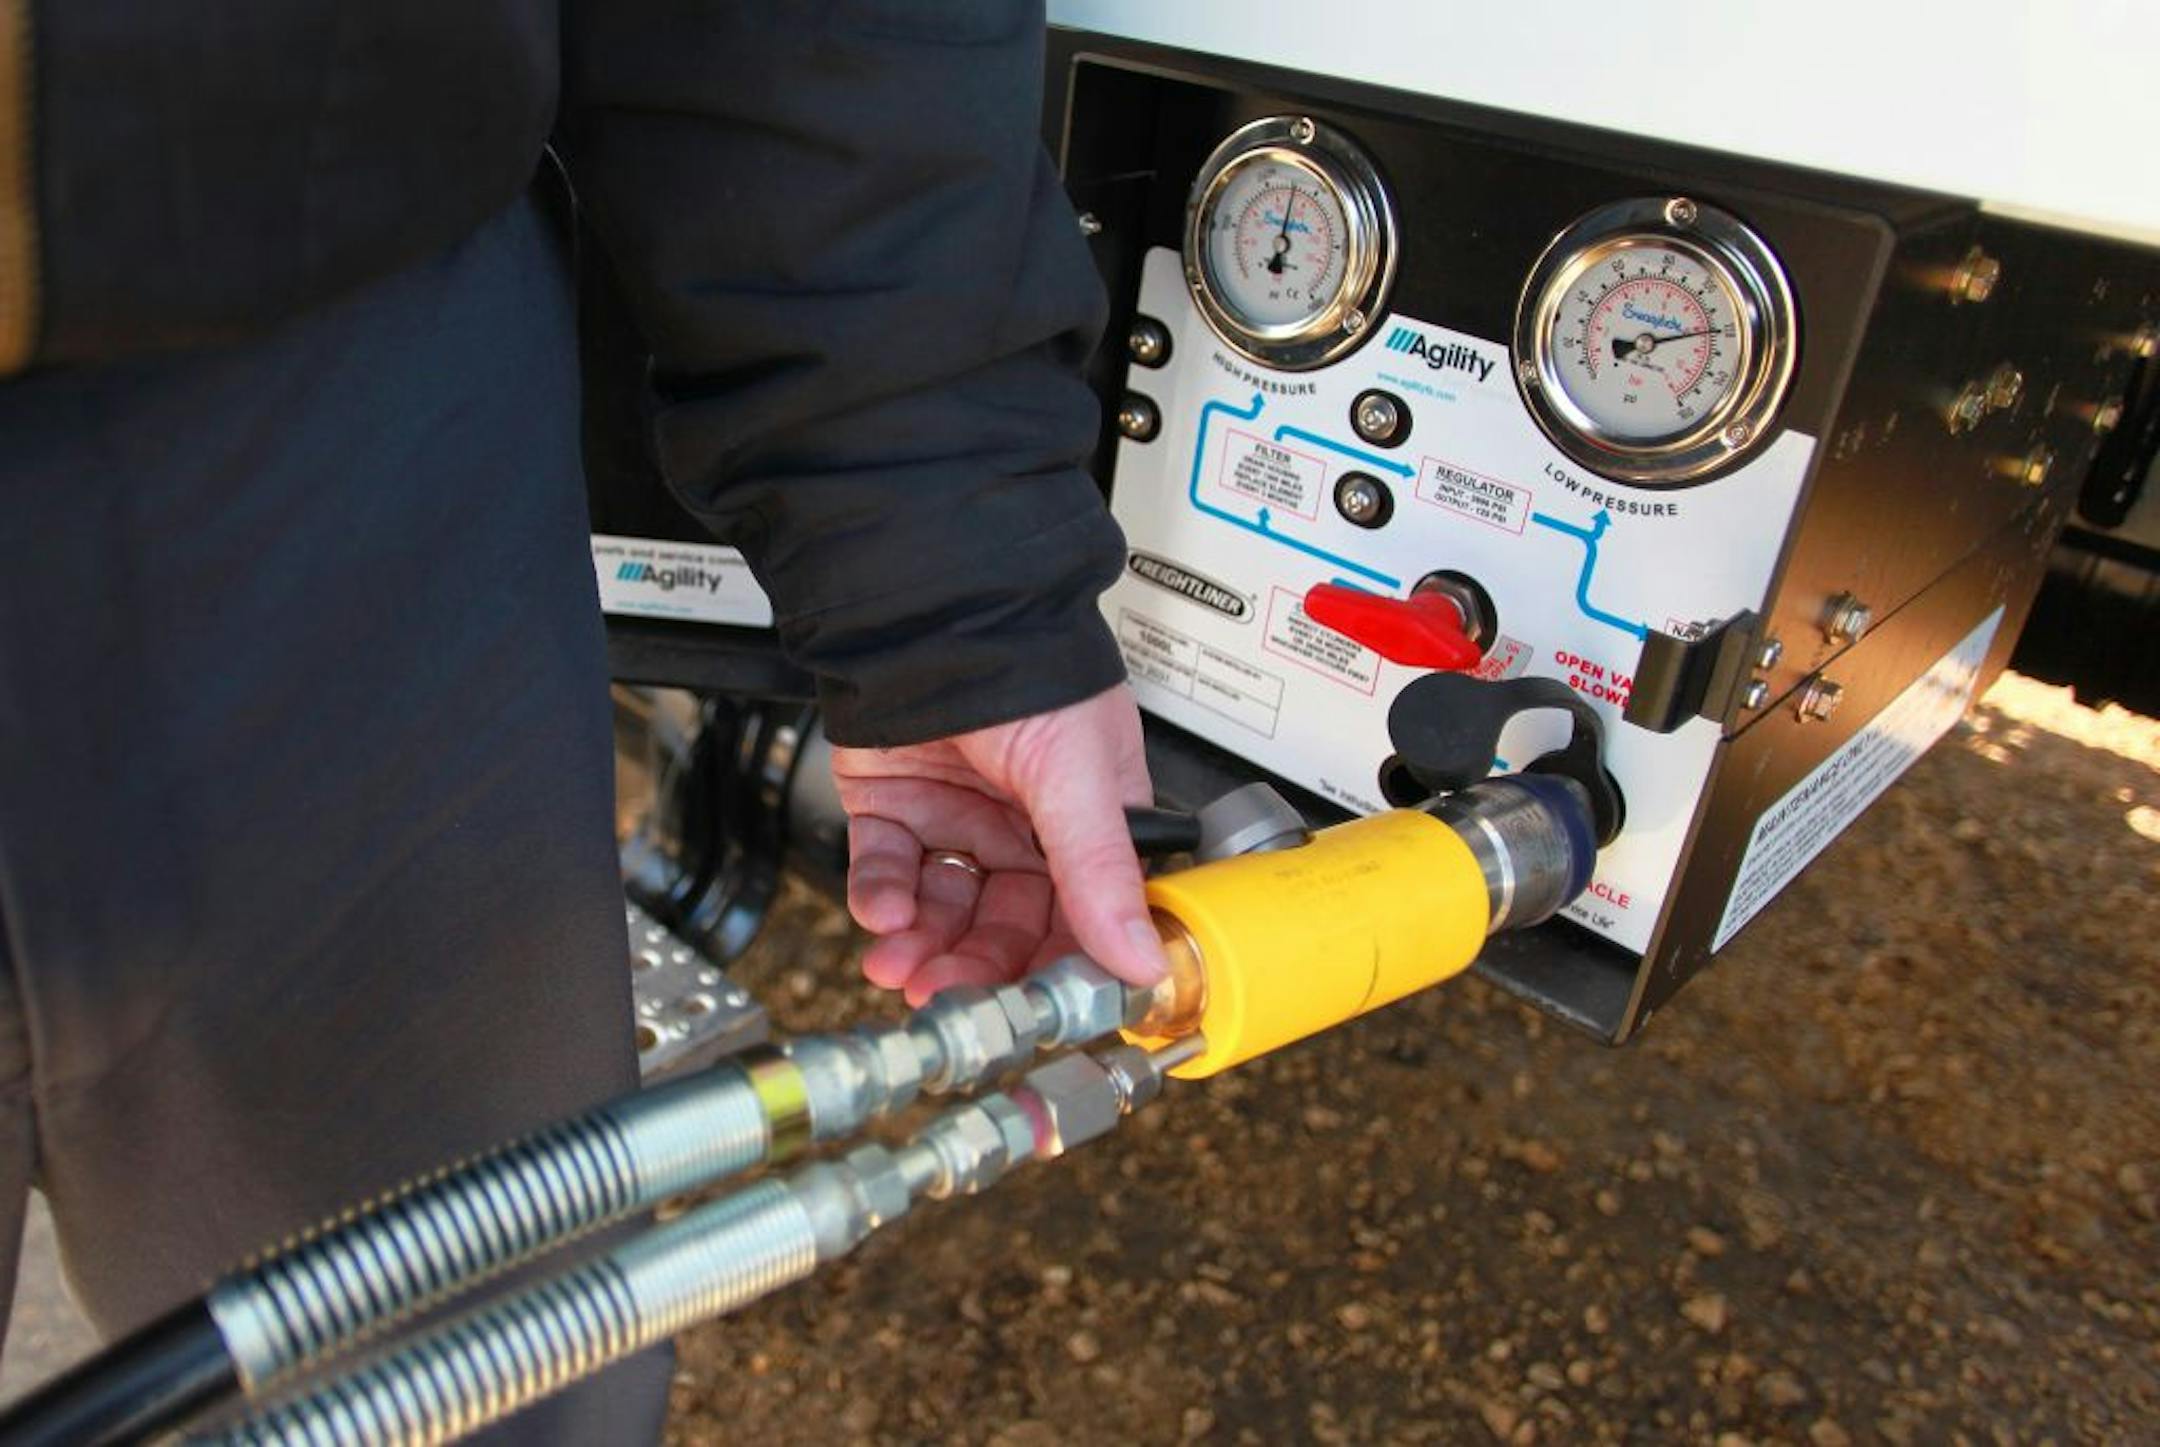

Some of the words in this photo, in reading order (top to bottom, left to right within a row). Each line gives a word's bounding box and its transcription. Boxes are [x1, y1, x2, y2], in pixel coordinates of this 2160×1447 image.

[1622, 302, 1681, 330] Swagelok
[1212, 351, 1242, 378] HIGH
[1243, 372, 1317, 395] PRESSURE
[1409, 334, 1496, 382] Agility
[1254, 444, 1291, 462] FILTER
[1436, 465, 1514, 502] REGULATOR
[1438, 484, 1465, 498] INPUT
[1492, 502, 1507, 513] PSI
[1544, 462, 1580, 492] LOW
[1581, 487, 1679, 516] PRESSURE
[1434, 493, 1469, 510] OUTPUT
[1492, 512, 1507, 523] PSI
[641, 564, 722, 593] Agility
[1132, 558, 1242, 615] FREIGHTLINER
[1555, 651, 1604, 680] OPEN
[1569, 674, 1632, 709] SLOW
